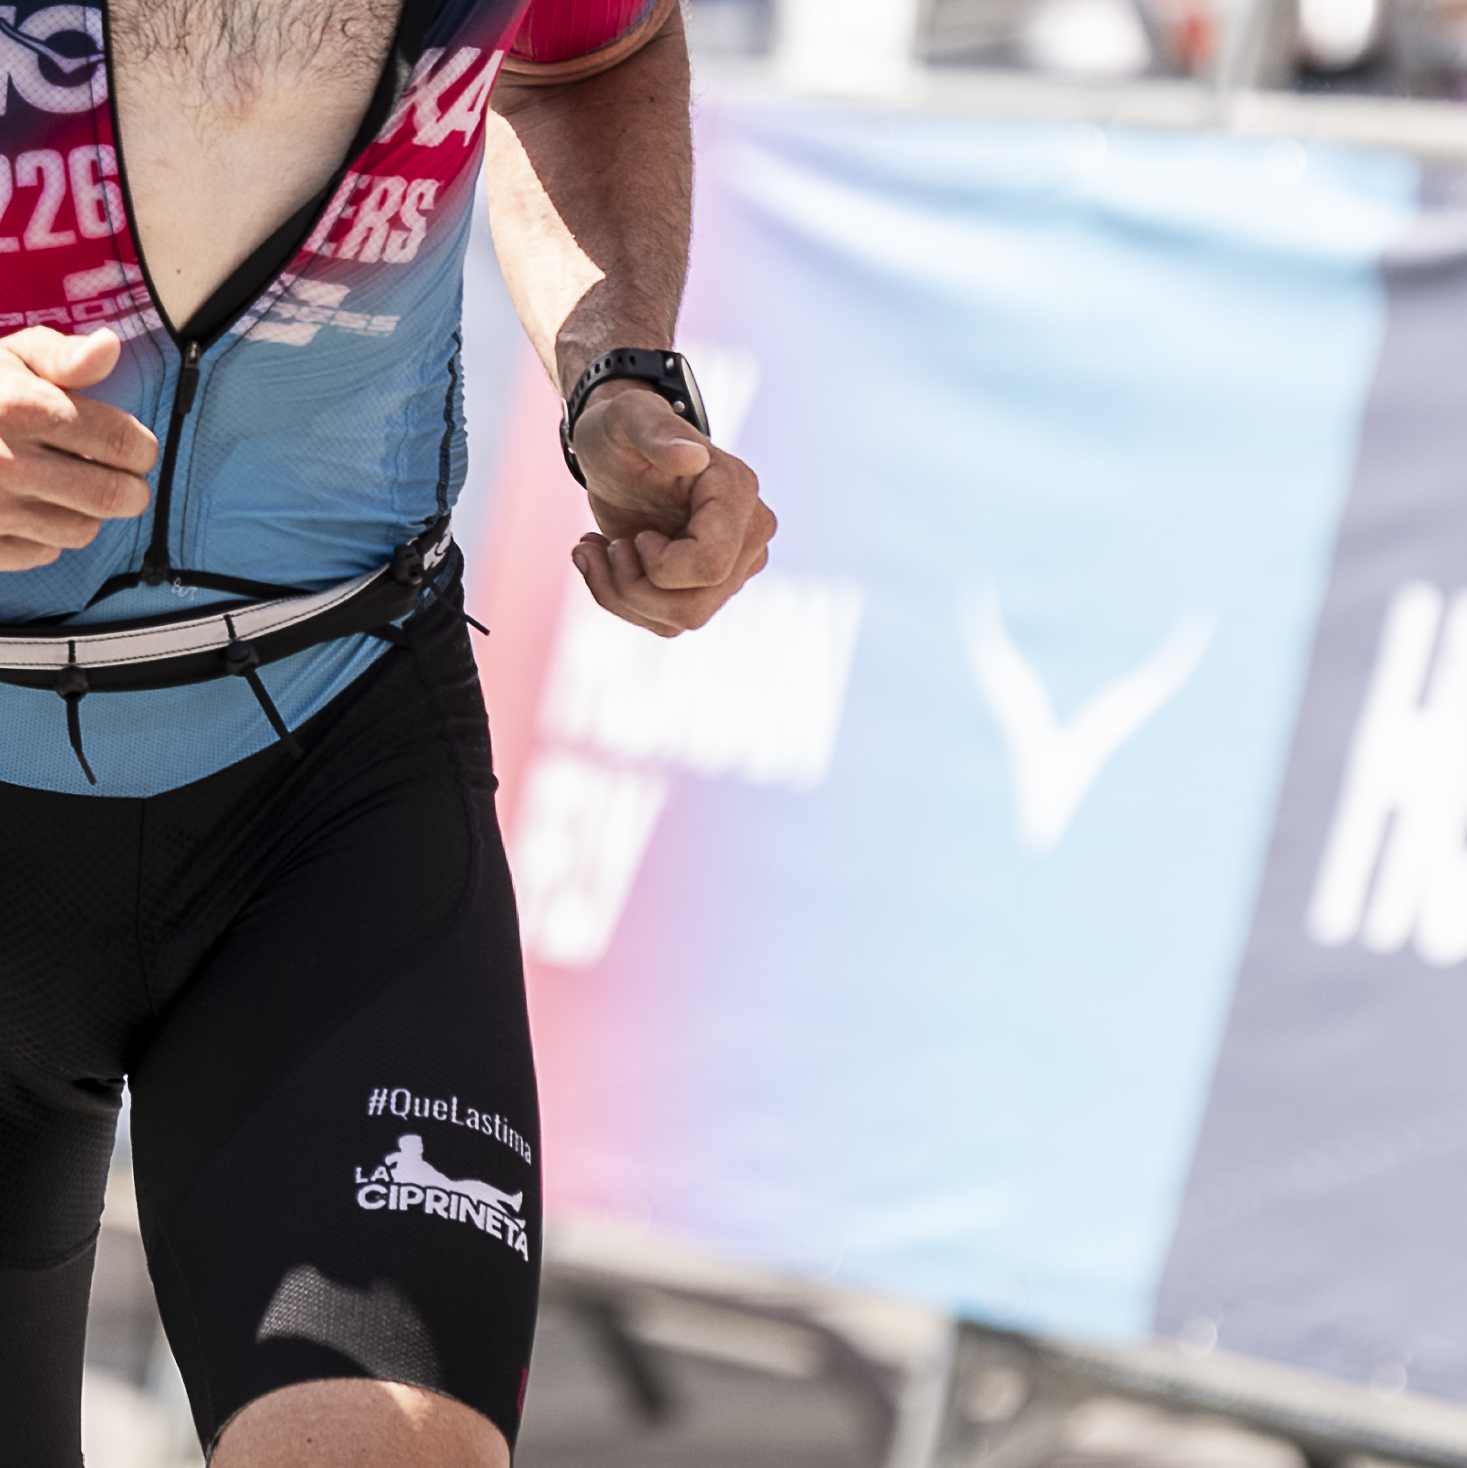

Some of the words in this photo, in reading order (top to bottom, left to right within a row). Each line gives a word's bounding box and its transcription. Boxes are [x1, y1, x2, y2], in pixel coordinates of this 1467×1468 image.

[368, 1088, 531, 1165] #QueLastima
[355, 1166, 390, 1183] LA
[357, 1184, 528, 1262] CIPRINETA
